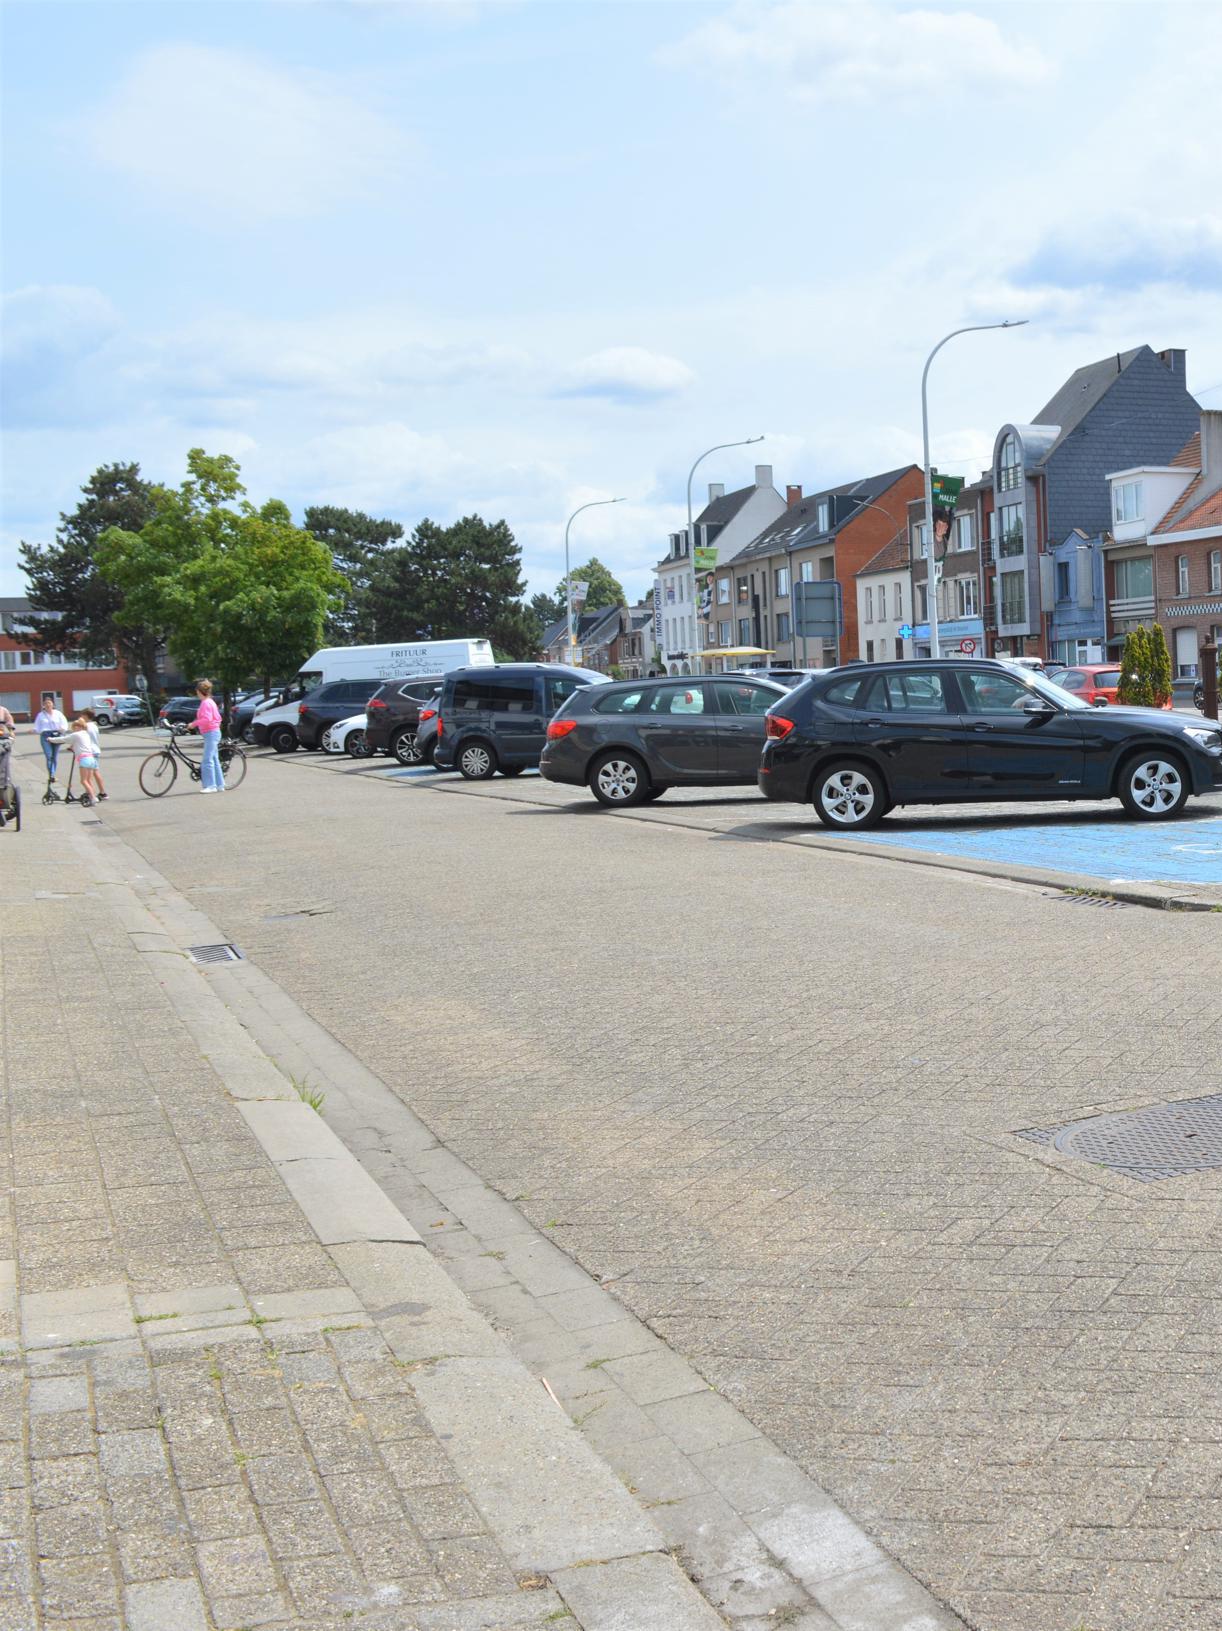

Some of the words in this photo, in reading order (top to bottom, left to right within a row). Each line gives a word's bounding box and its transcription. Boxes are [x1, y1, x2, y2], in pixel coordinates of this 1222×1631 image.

[654, 587, 662, 611] POINT
[655, 613, 663, 637] IMMO
[391, 649, 428, 658] FRITUUR
[378, 670, 391, 678] The
